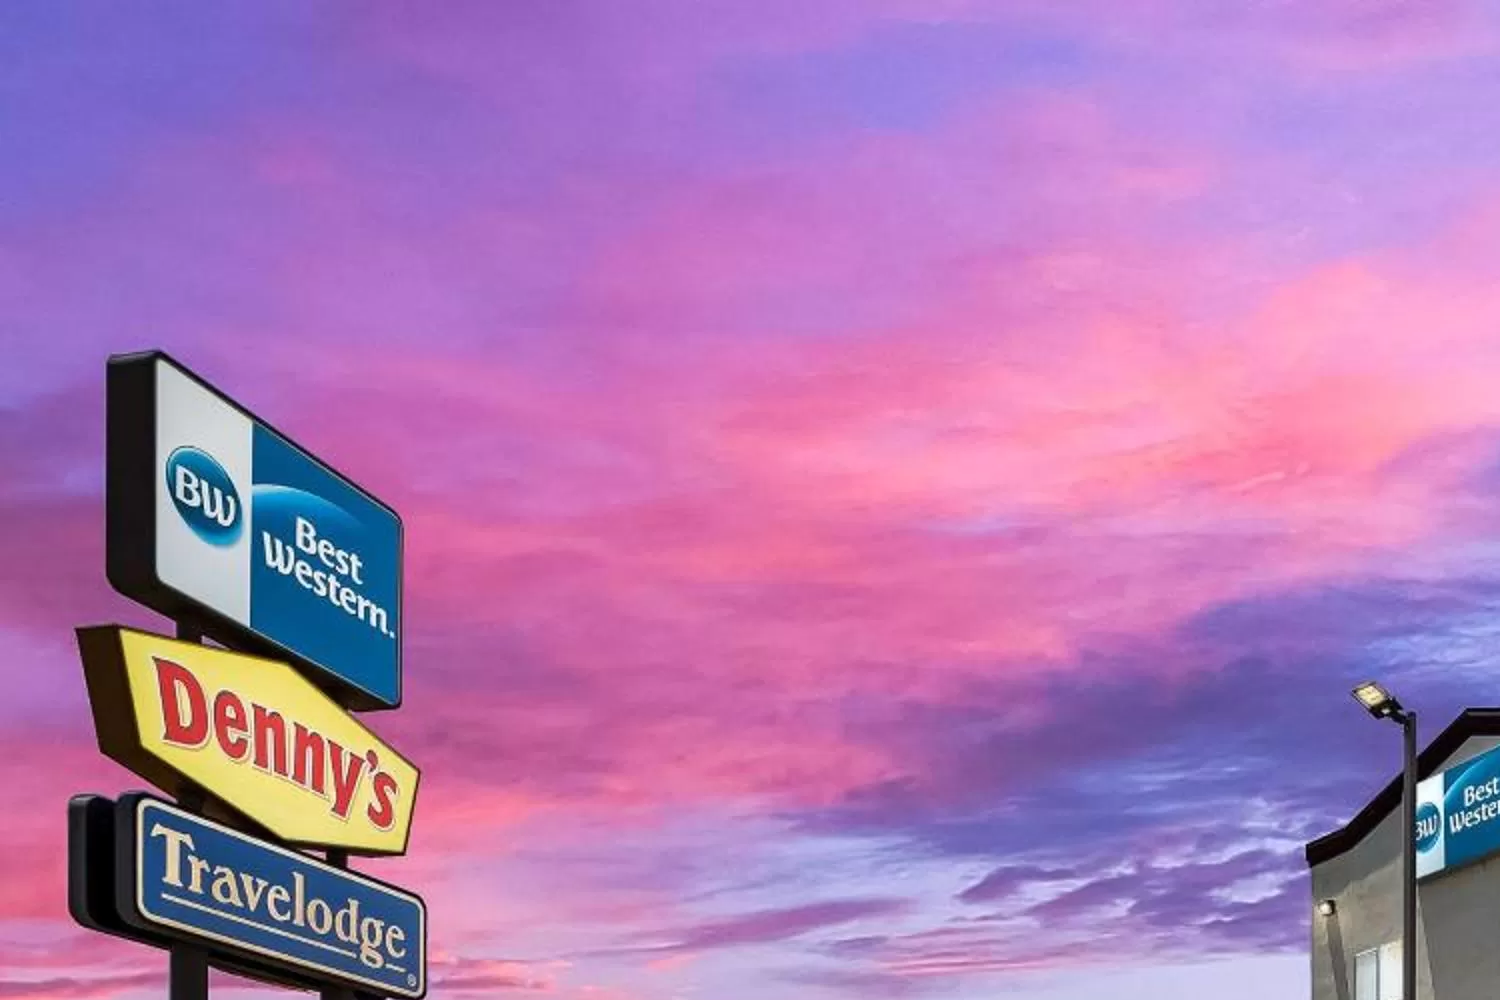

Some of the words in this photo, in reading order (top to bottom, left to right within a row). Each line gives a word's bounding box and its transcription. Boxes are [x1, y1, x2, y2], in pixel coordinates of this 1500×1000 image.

[174, 465, 235, 526] BW
[295, 515, 363, 585] Best
[152, 655, 398, 830] Denny's
[1463, 776, 1500, 807] Best
[150, 823, 406, 968] Travelodge
